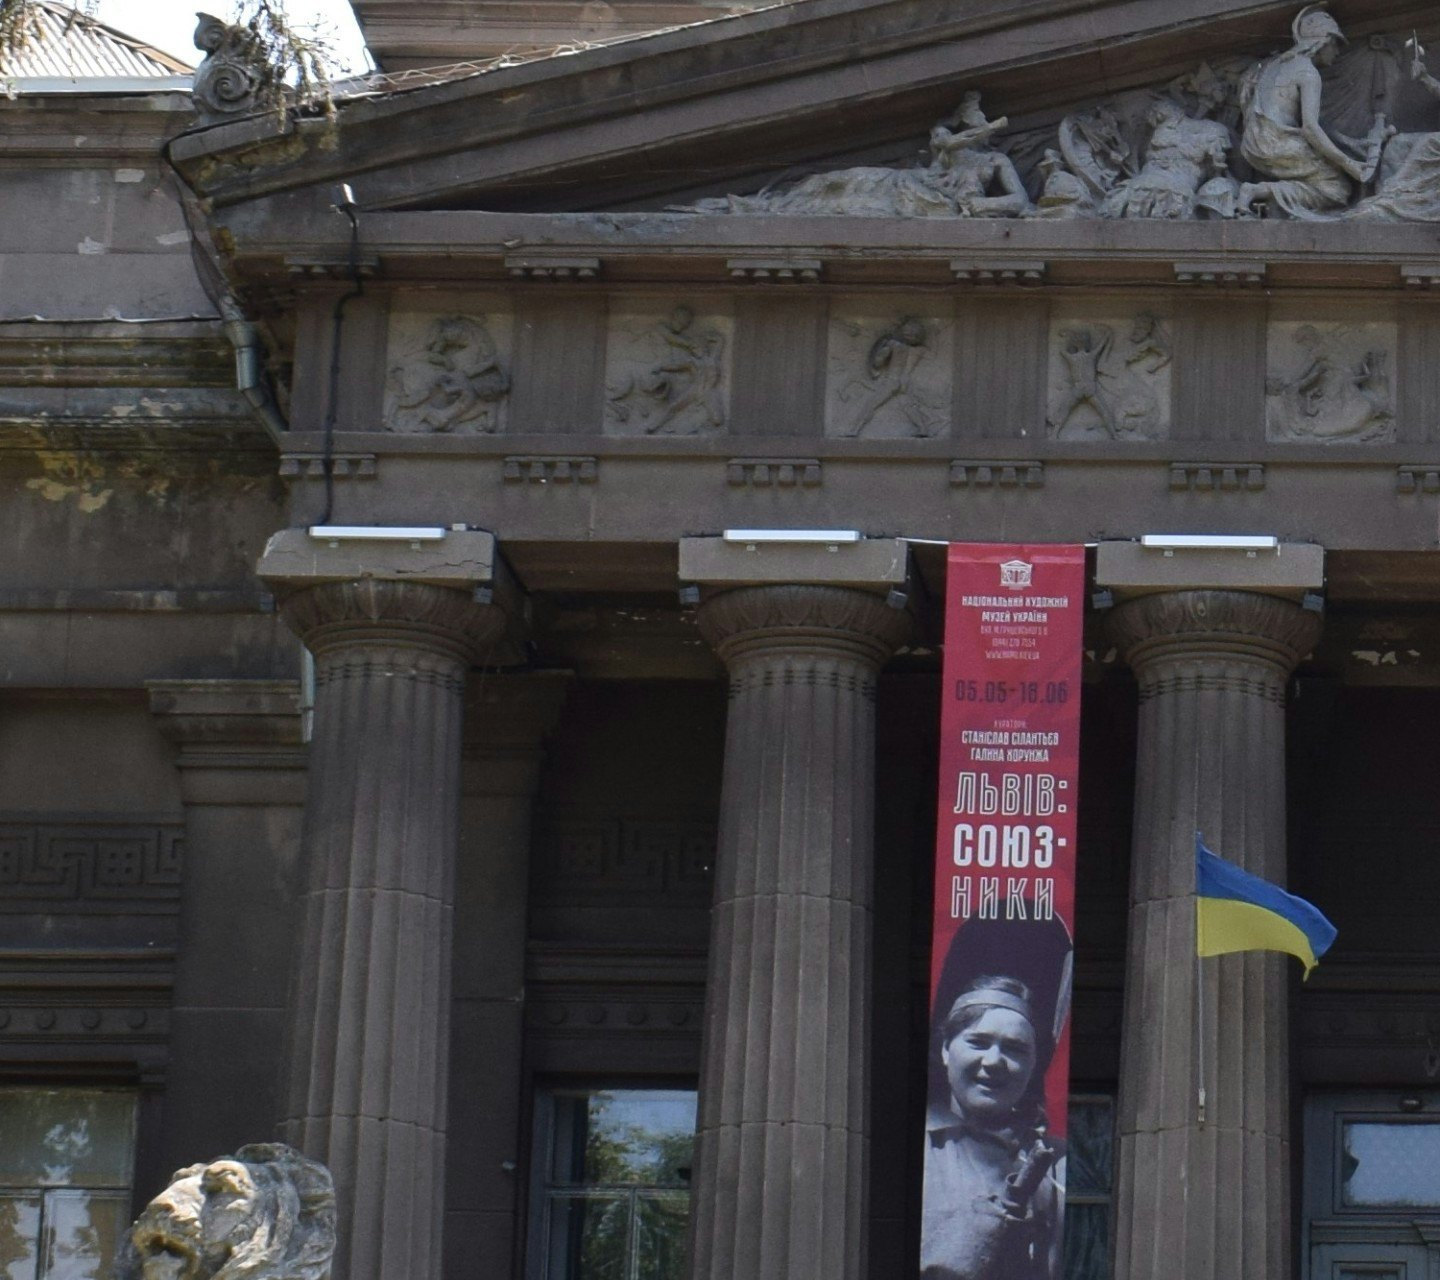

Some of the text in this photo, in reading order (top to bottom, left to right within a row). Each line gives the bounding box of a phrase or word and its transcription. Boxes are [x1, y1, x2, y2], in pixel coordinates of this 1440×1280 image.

[982, 610, 1048, 622] МУЗЕЙ УКРАЇНИ
[962, 731, 1059, 746] СТАНІСЛАВ СІЛАНТЬЄВ
[971, 748, 1049, 762] ГАЛИНА ХОРУНЖА
[954, 772, 1067, 816] ЛЬВІВ:
[951, 876, 1054, 920] НИКИ
